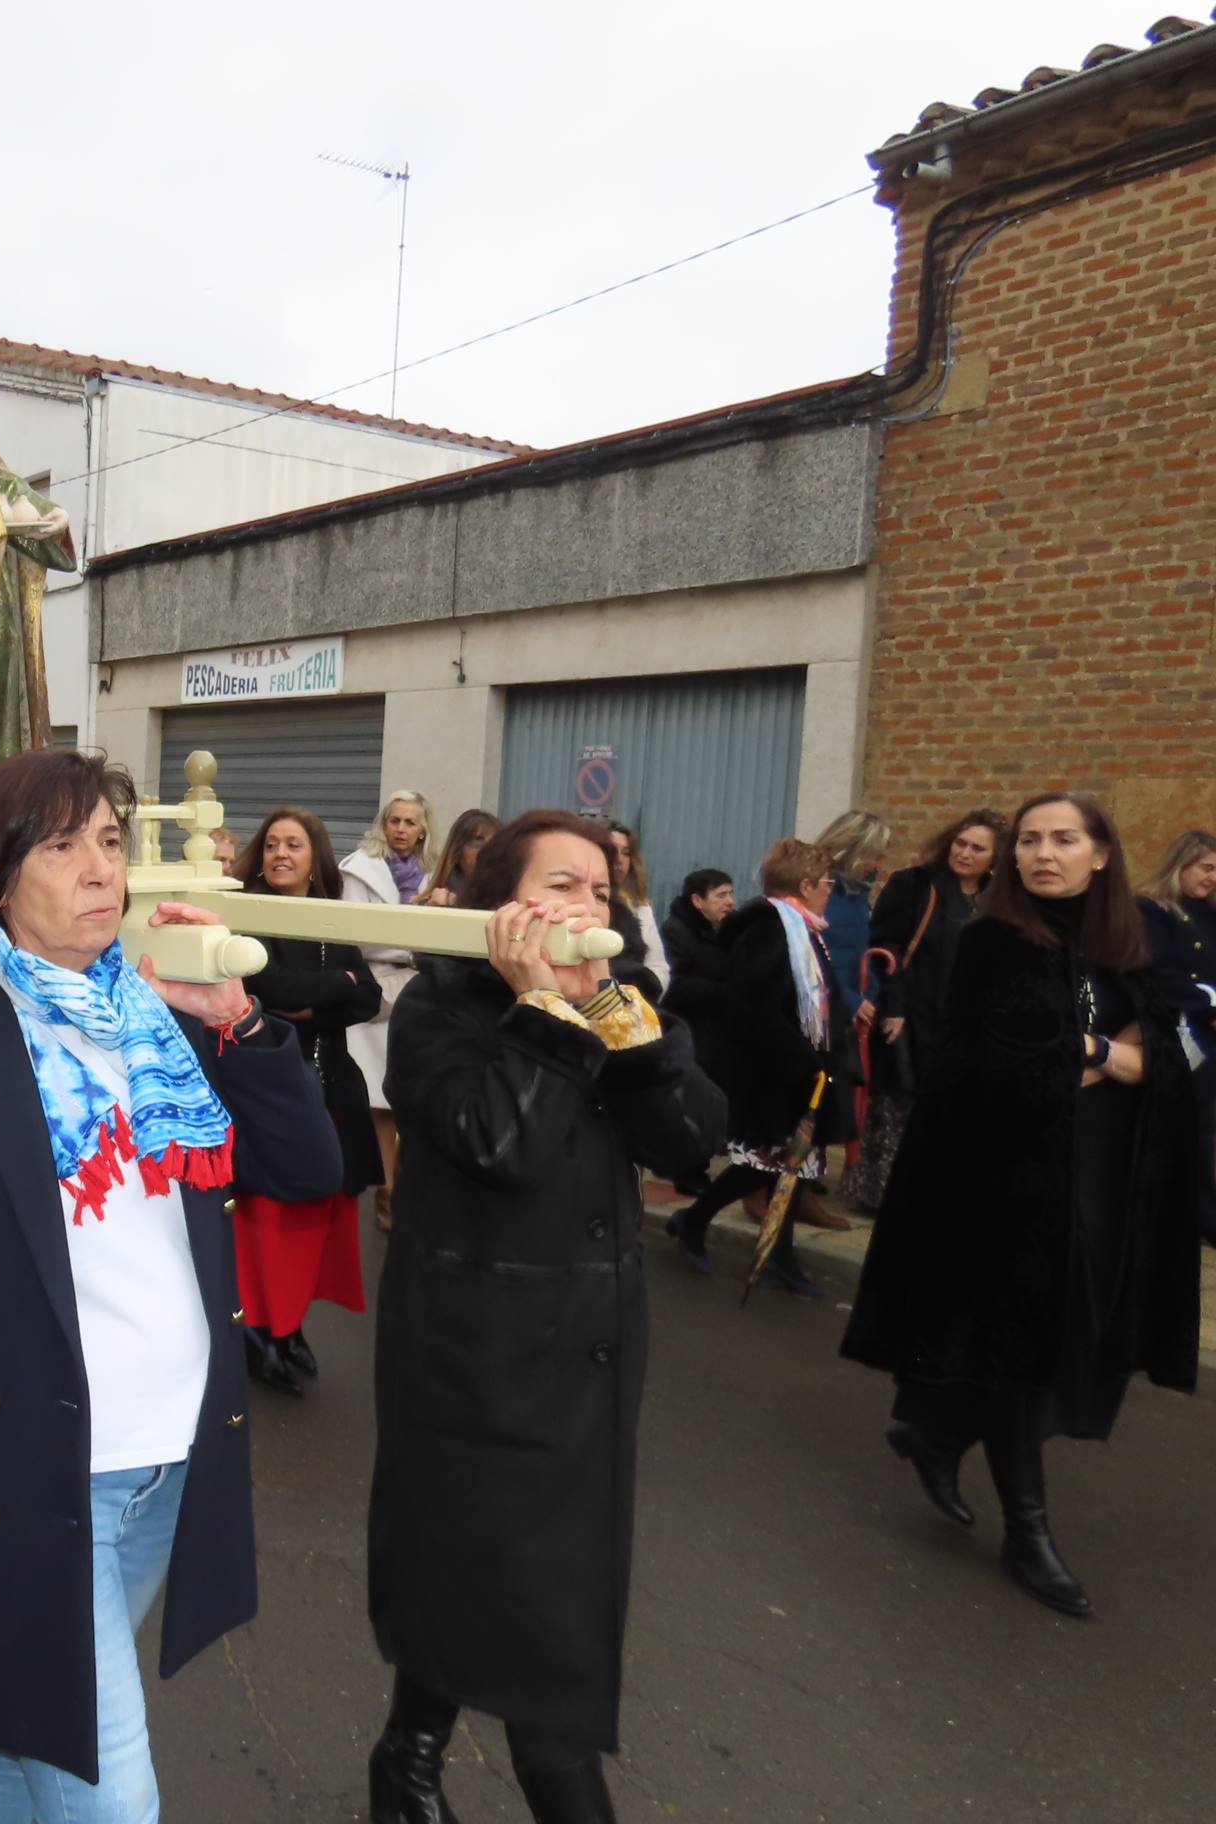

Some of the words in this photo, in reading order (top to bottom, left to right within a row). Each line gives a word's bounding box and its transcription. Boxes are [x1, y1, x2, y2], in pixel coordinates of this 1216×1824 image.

[186, 664, 258, 697] PESCADERIA
[270, 648, 336, 692] FRUTERIA
[230, 645, 294, 667] FELIX
